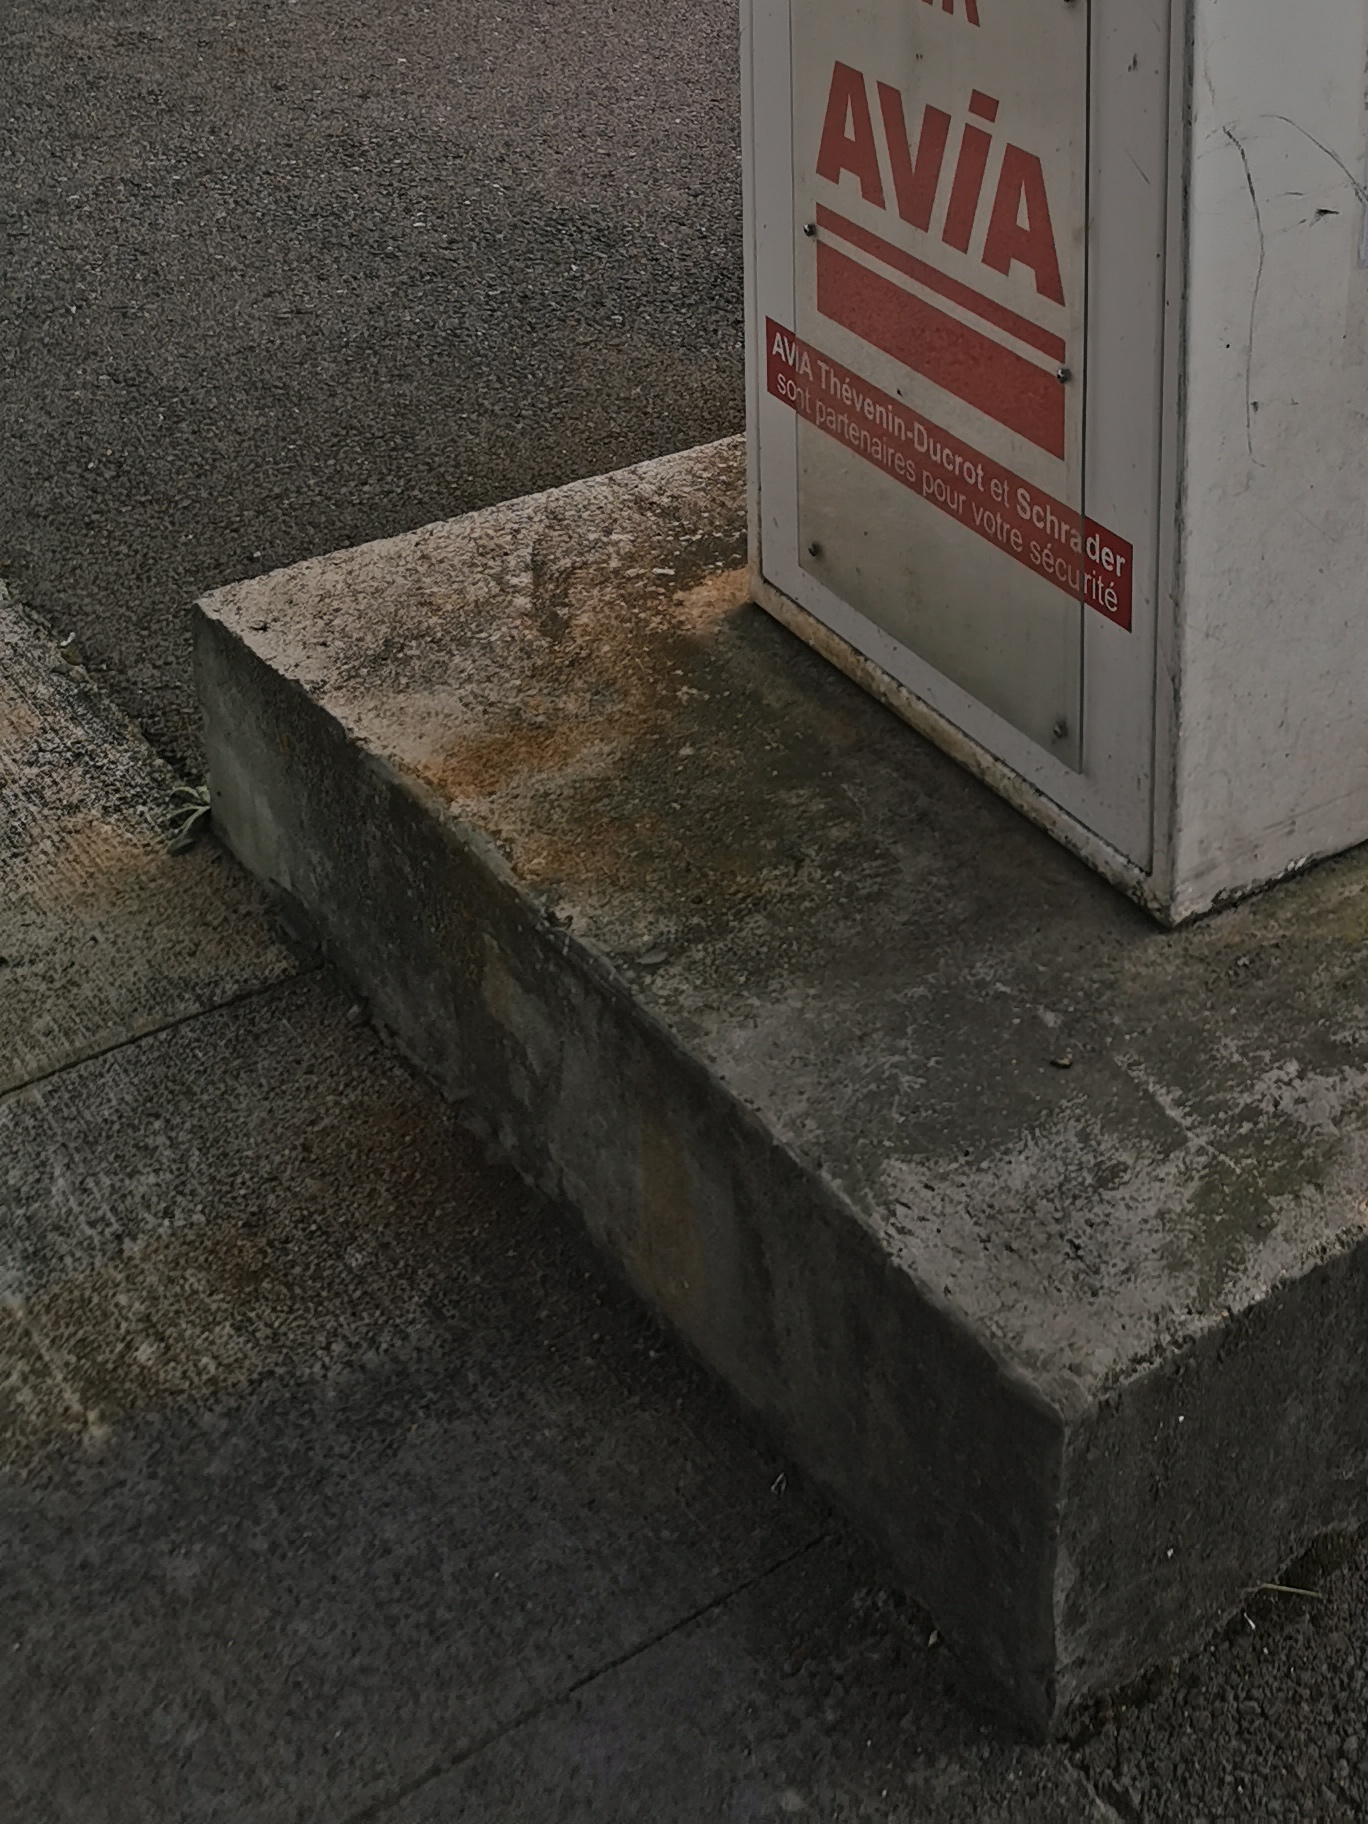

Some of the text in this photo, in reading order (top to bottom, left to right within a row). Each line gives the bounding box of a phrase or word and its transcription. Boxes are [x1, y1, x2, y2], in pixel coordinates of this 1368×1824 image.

[772, 330, 1127, 578] AVIA Thévenin-Ducrot et Schrader
[776, 372, 1119, 613] sont partenaires pour votre sécurité
